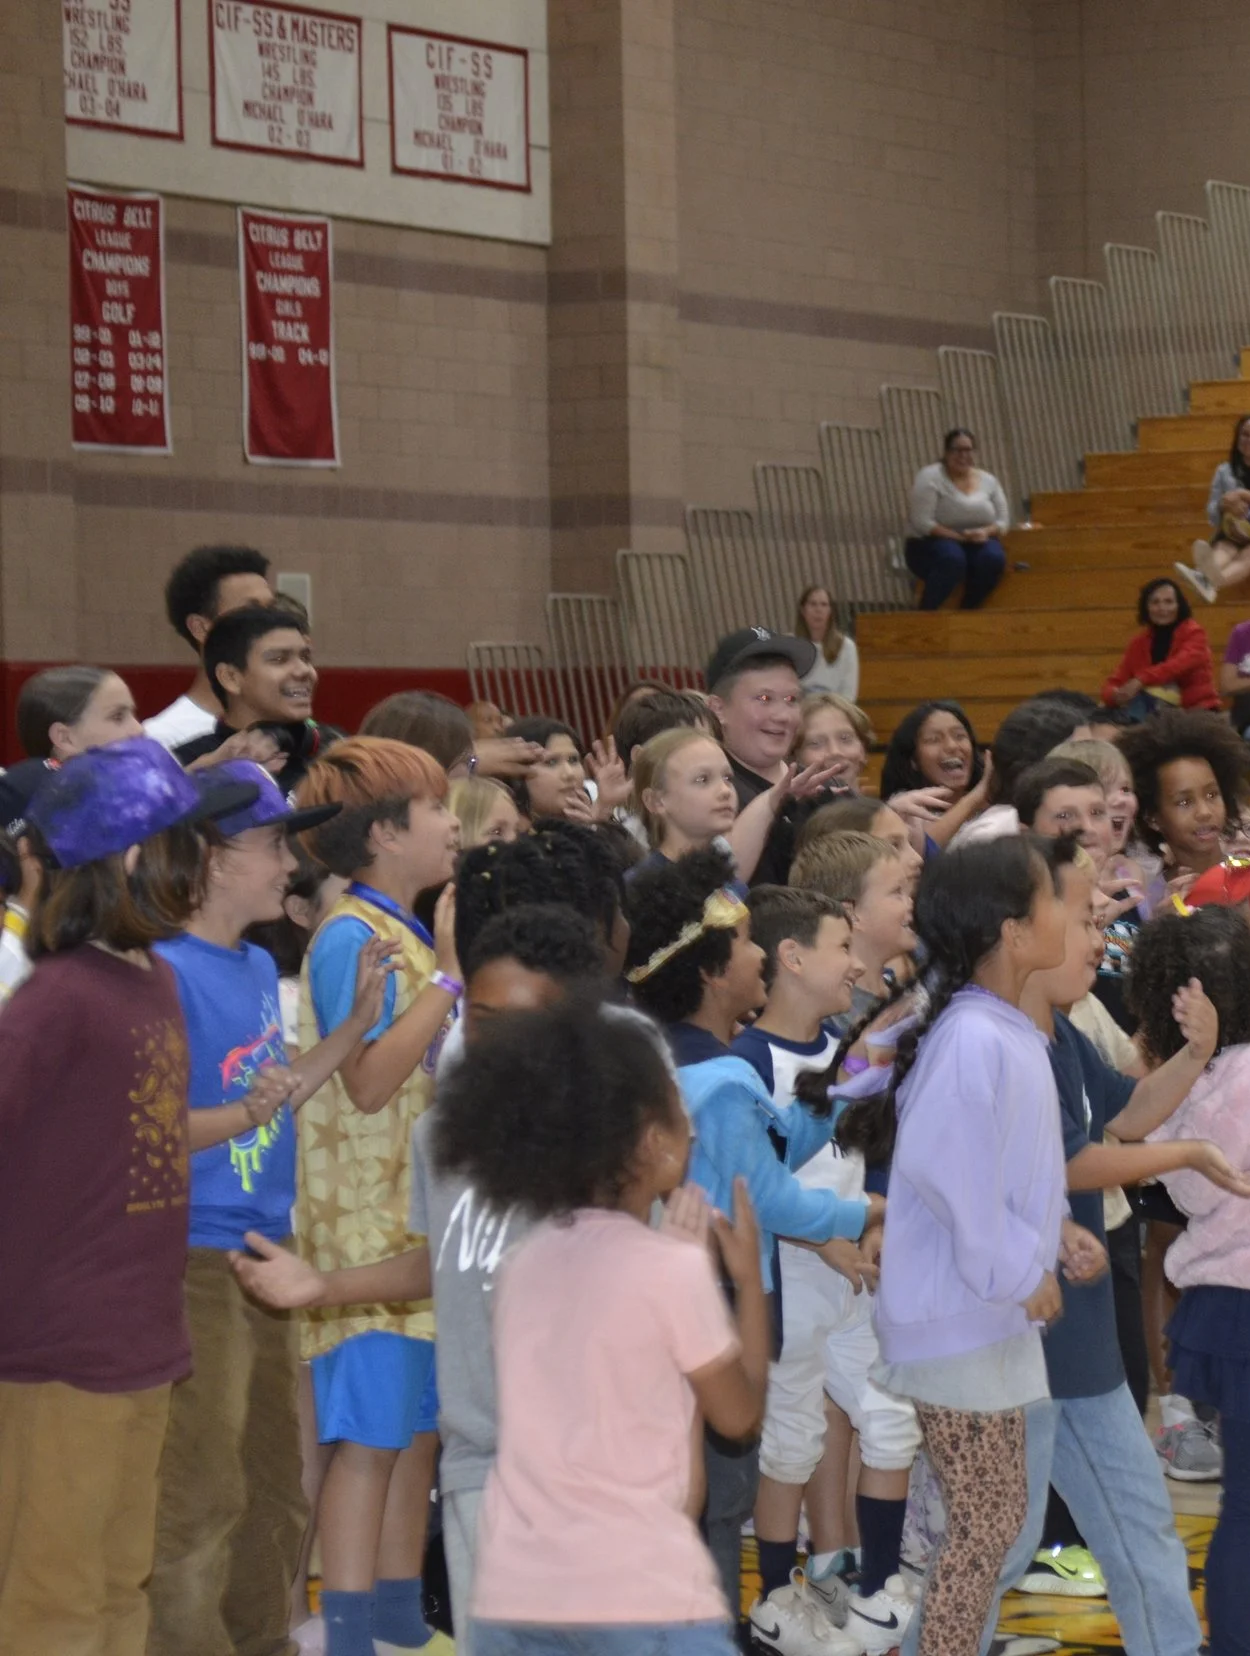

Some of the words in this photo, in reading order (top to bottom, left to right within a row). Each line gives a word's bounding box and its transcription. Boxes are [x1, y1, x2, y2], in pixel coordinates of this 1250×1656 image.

[64, 7, 131, 35] WRESTLING
[277, 14, 288, 41] &
[291, 16, 356, 53] MASTERS
[71, 50, 126, 76] CHAMPION
[258, 40, 317, 69] WRESTLING
[262, 81, 314, 107] CHAMPION
[434, 73, 486, 99] WRESTLING
[243, 99, 286, 126] MICHAEL
[438, 113, 484, 136] CHAMPION
[413, 129, 454, 152] MICHAEL
[73, 198, 117, 225] CITRUS
[123, 205, 152, 229] BELT
[95, 228, 132, 250] LEAGUE
[248, 221, 289, 249] CITRUS
[293, 228, 323, 252] BELT
[82, 248, 151, 278] CHAMPIONS
[268, 249, 304, 273] LEAGUE
[255, 270, 321, 299] CHAMPIONS
[101, 300, 136, 325] GOLF
[271, 319, 310, 343] TRACK
